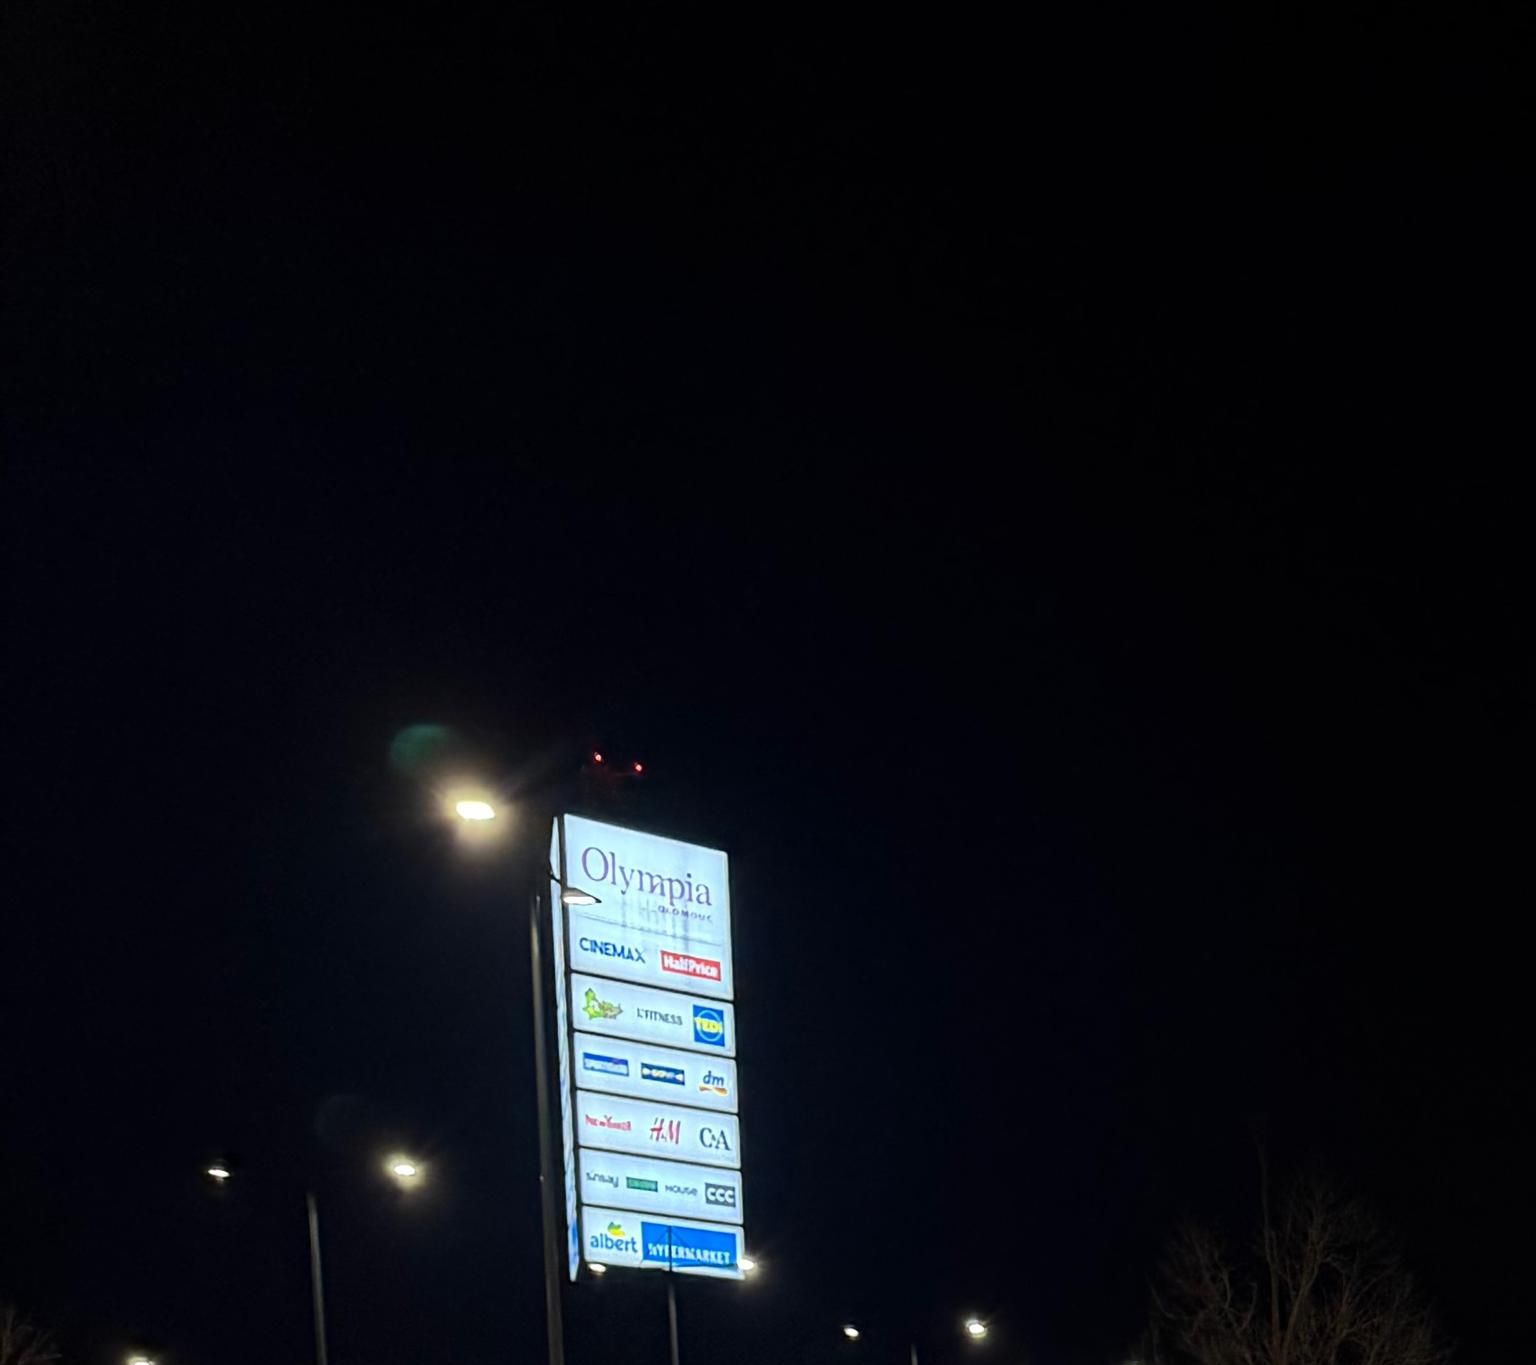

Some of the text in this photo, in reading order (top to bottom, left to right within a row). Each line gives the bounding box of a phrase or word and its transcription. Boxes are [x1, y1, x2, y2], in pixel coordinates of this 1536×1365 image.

[582, 846, 712, 906] Olympia
[579, 938, 645, 963] CINEMAX
[703, 1070, 724, 1086] dm
[699, 1127, 731, 1151] C&A
[706, 1187, 735, 1203] CCC
[590, 1233, 637, 1253] albert
